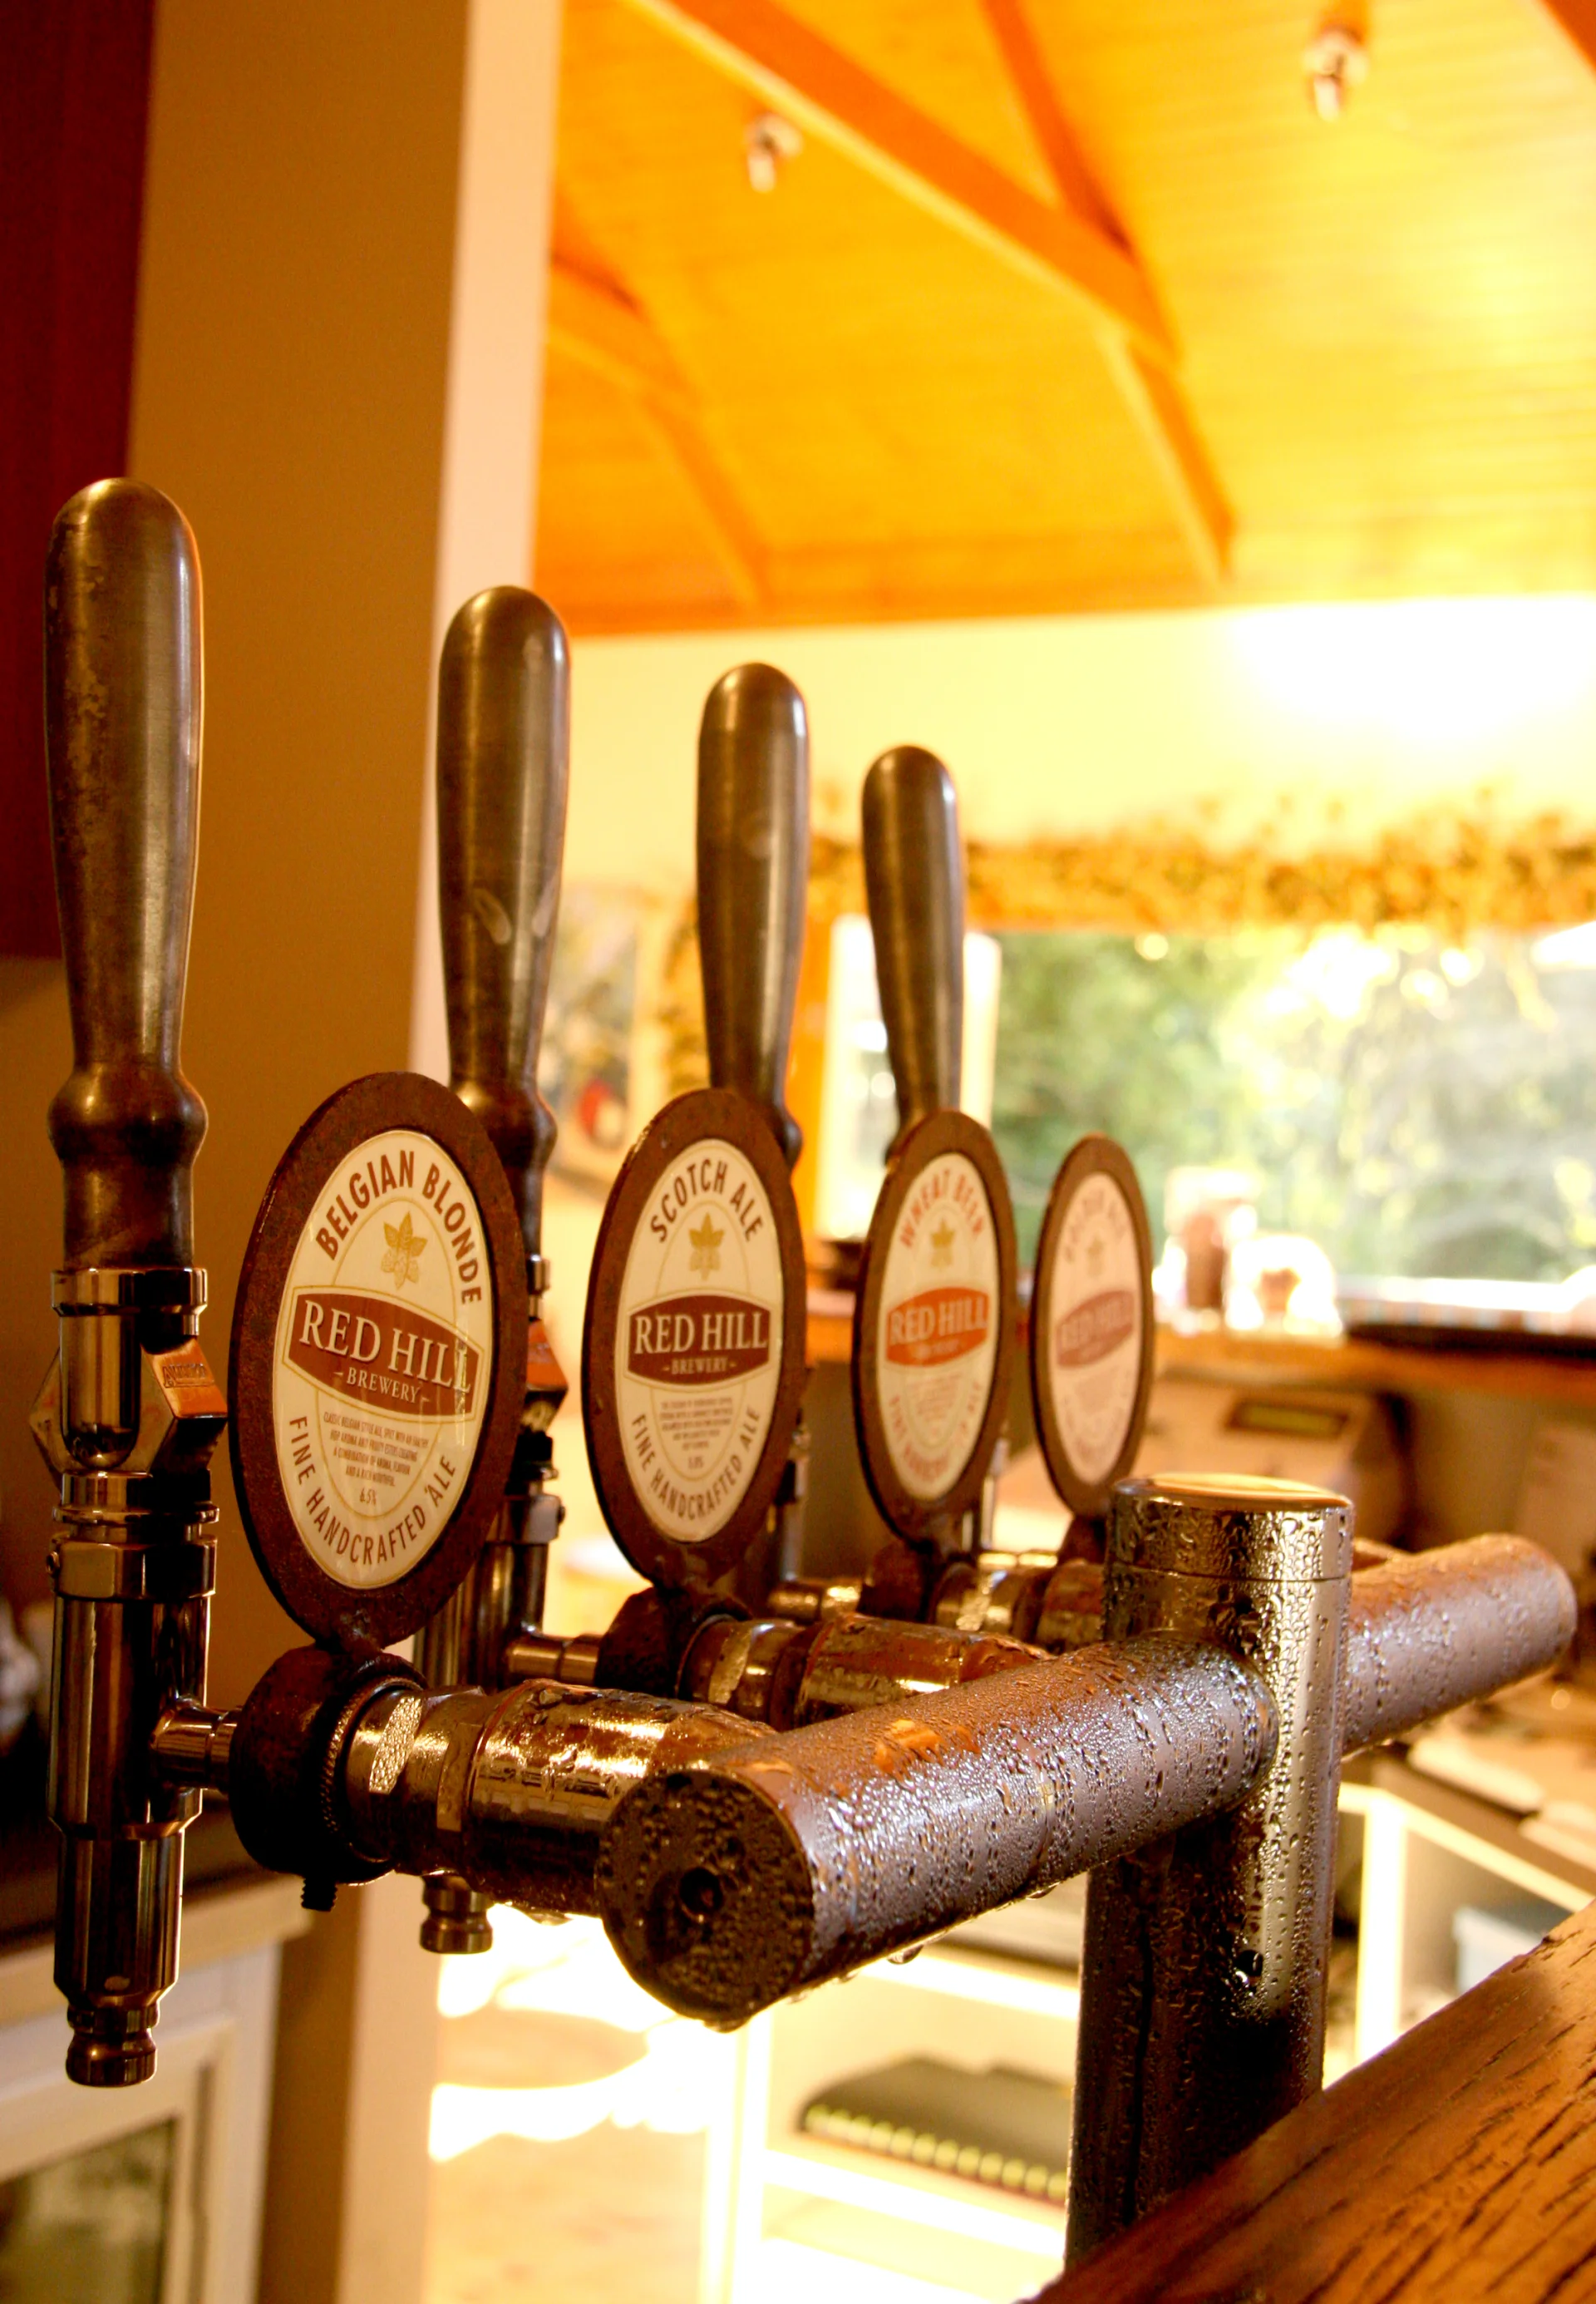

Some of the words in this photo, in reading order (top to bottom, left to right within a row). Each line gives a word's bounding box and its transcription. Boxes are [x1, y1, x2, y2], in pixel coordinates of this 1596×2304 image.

[316, 1150, 414, 1261] BELGIAN
[422, 1163, 481, 1305] BLONDE
[651, 1158, 727, 1242] SCOTCH
[730, 1182, 763, 1241] ALE
[299, 1300, 381, 1363] RED
[388, 1328, 470, 1394] HILL
[634, 1314, 695, 1354] RED
[702, 1311, 767, 1351] HILL
[890, 1304, 935, 1344] RED
[938, 1295, 988, 1335] HILL
[289, 1416, 316, 1484] FINE
[306, 1487, 426, 1565] HANDCRAFTED
[425, 1455, 456, 1507] ALE
[632, 1414, 655, 1472] FINE
[651, 1454, 741, 1520] HANDCRAFTED
[740, 1407, 759, 1452] ALE
